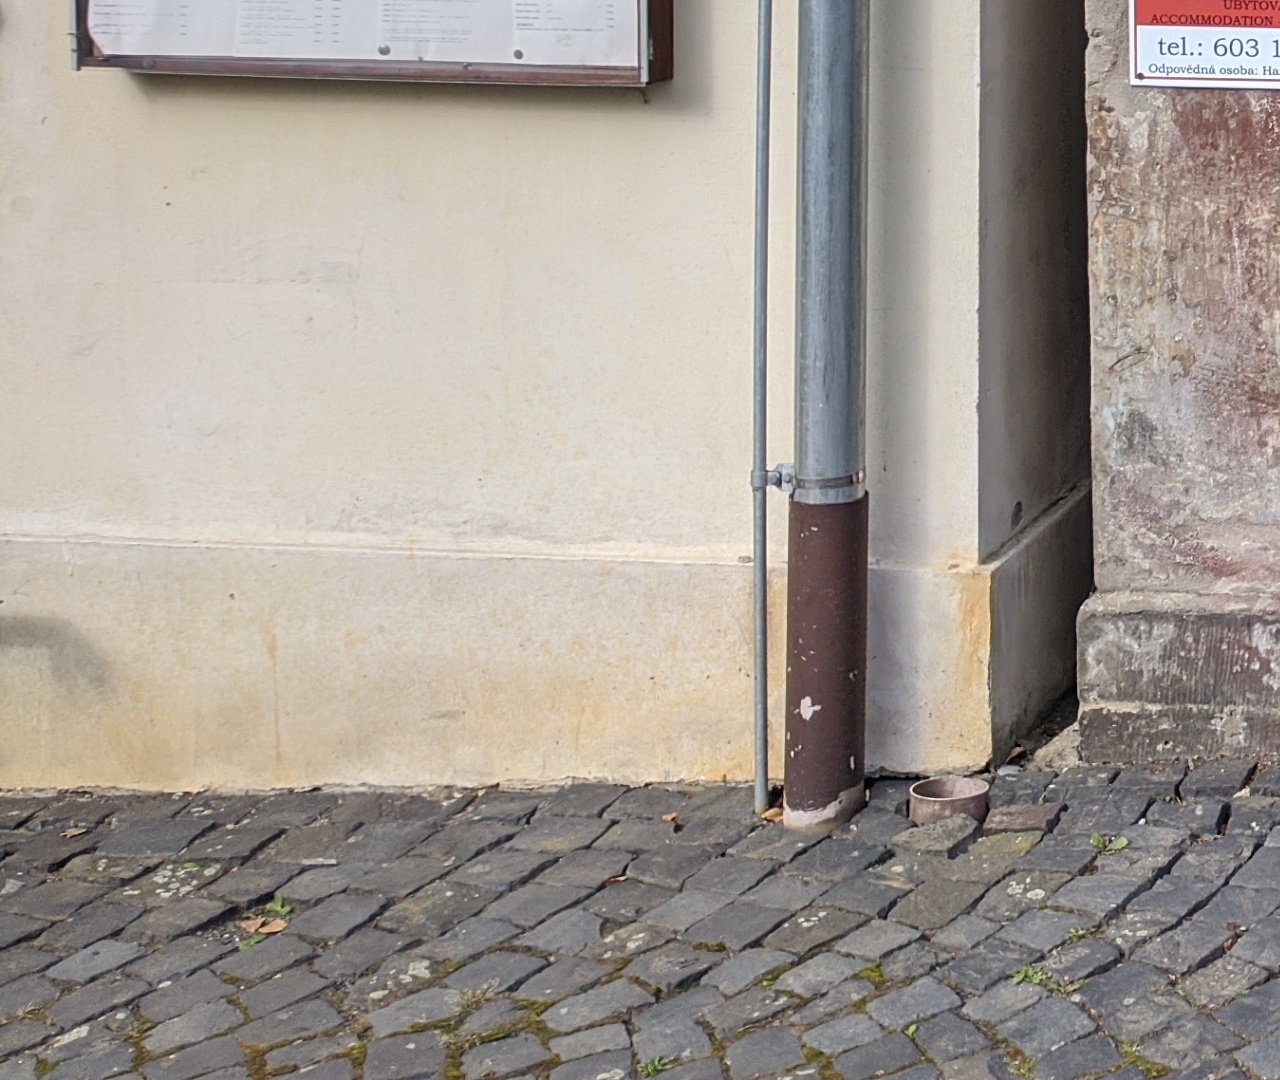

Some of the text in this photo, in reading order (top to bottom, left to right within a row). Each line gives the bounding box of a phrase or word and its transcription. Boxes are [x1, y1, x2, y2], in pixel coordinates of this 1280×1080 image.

[1151, 15, 1273, 26] ACCOMMODATION
[1158, 37, 1203, 56] tel.:
[1213, 38, 1259, 57] 603
[1149, 64, 1215, 77] Odpovědná
[1220, 66, 1258, 76] osoba:
